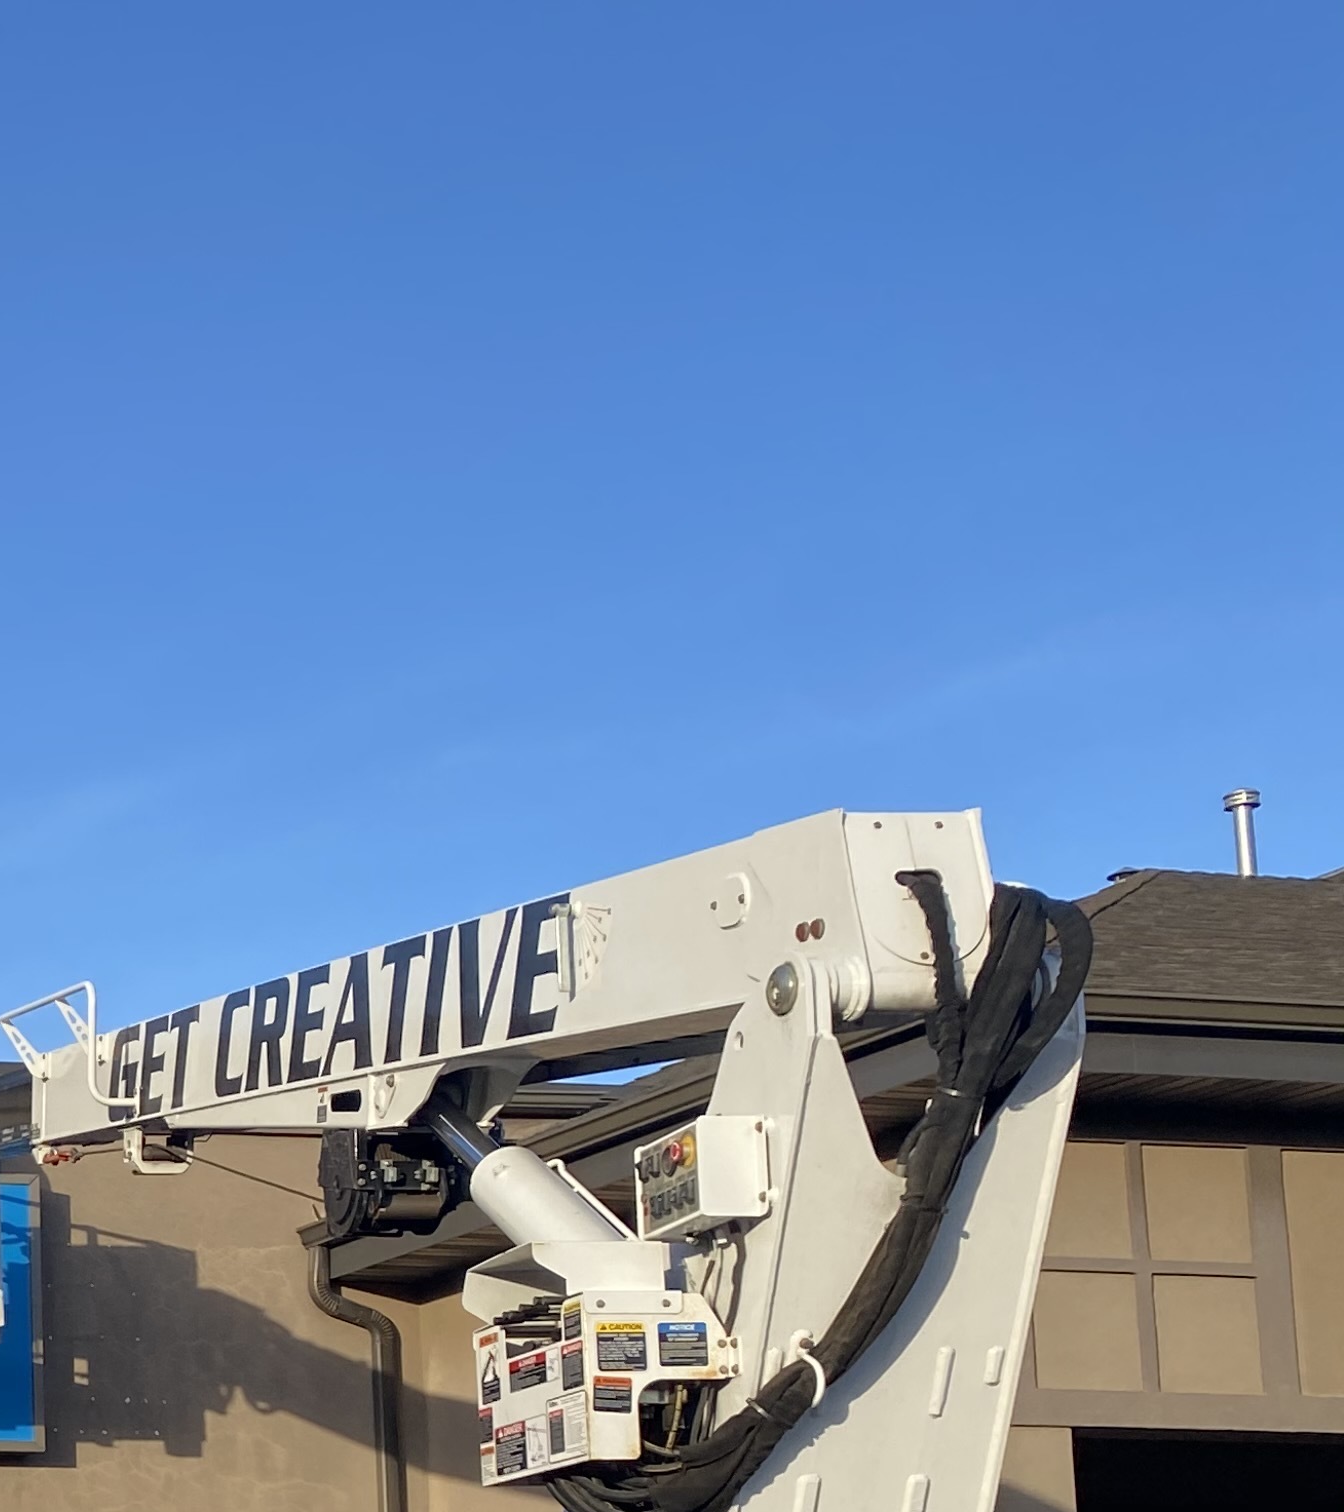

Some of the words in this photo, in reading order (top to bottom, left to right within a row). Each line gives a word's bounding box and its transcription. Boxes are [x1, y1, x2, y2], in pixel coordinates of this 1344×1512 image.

[109, 1004, 200, 1122] GET
[215, 892, 570, 1097] CREATIVE
[608, 1323, 643, 1331] CAUTION
